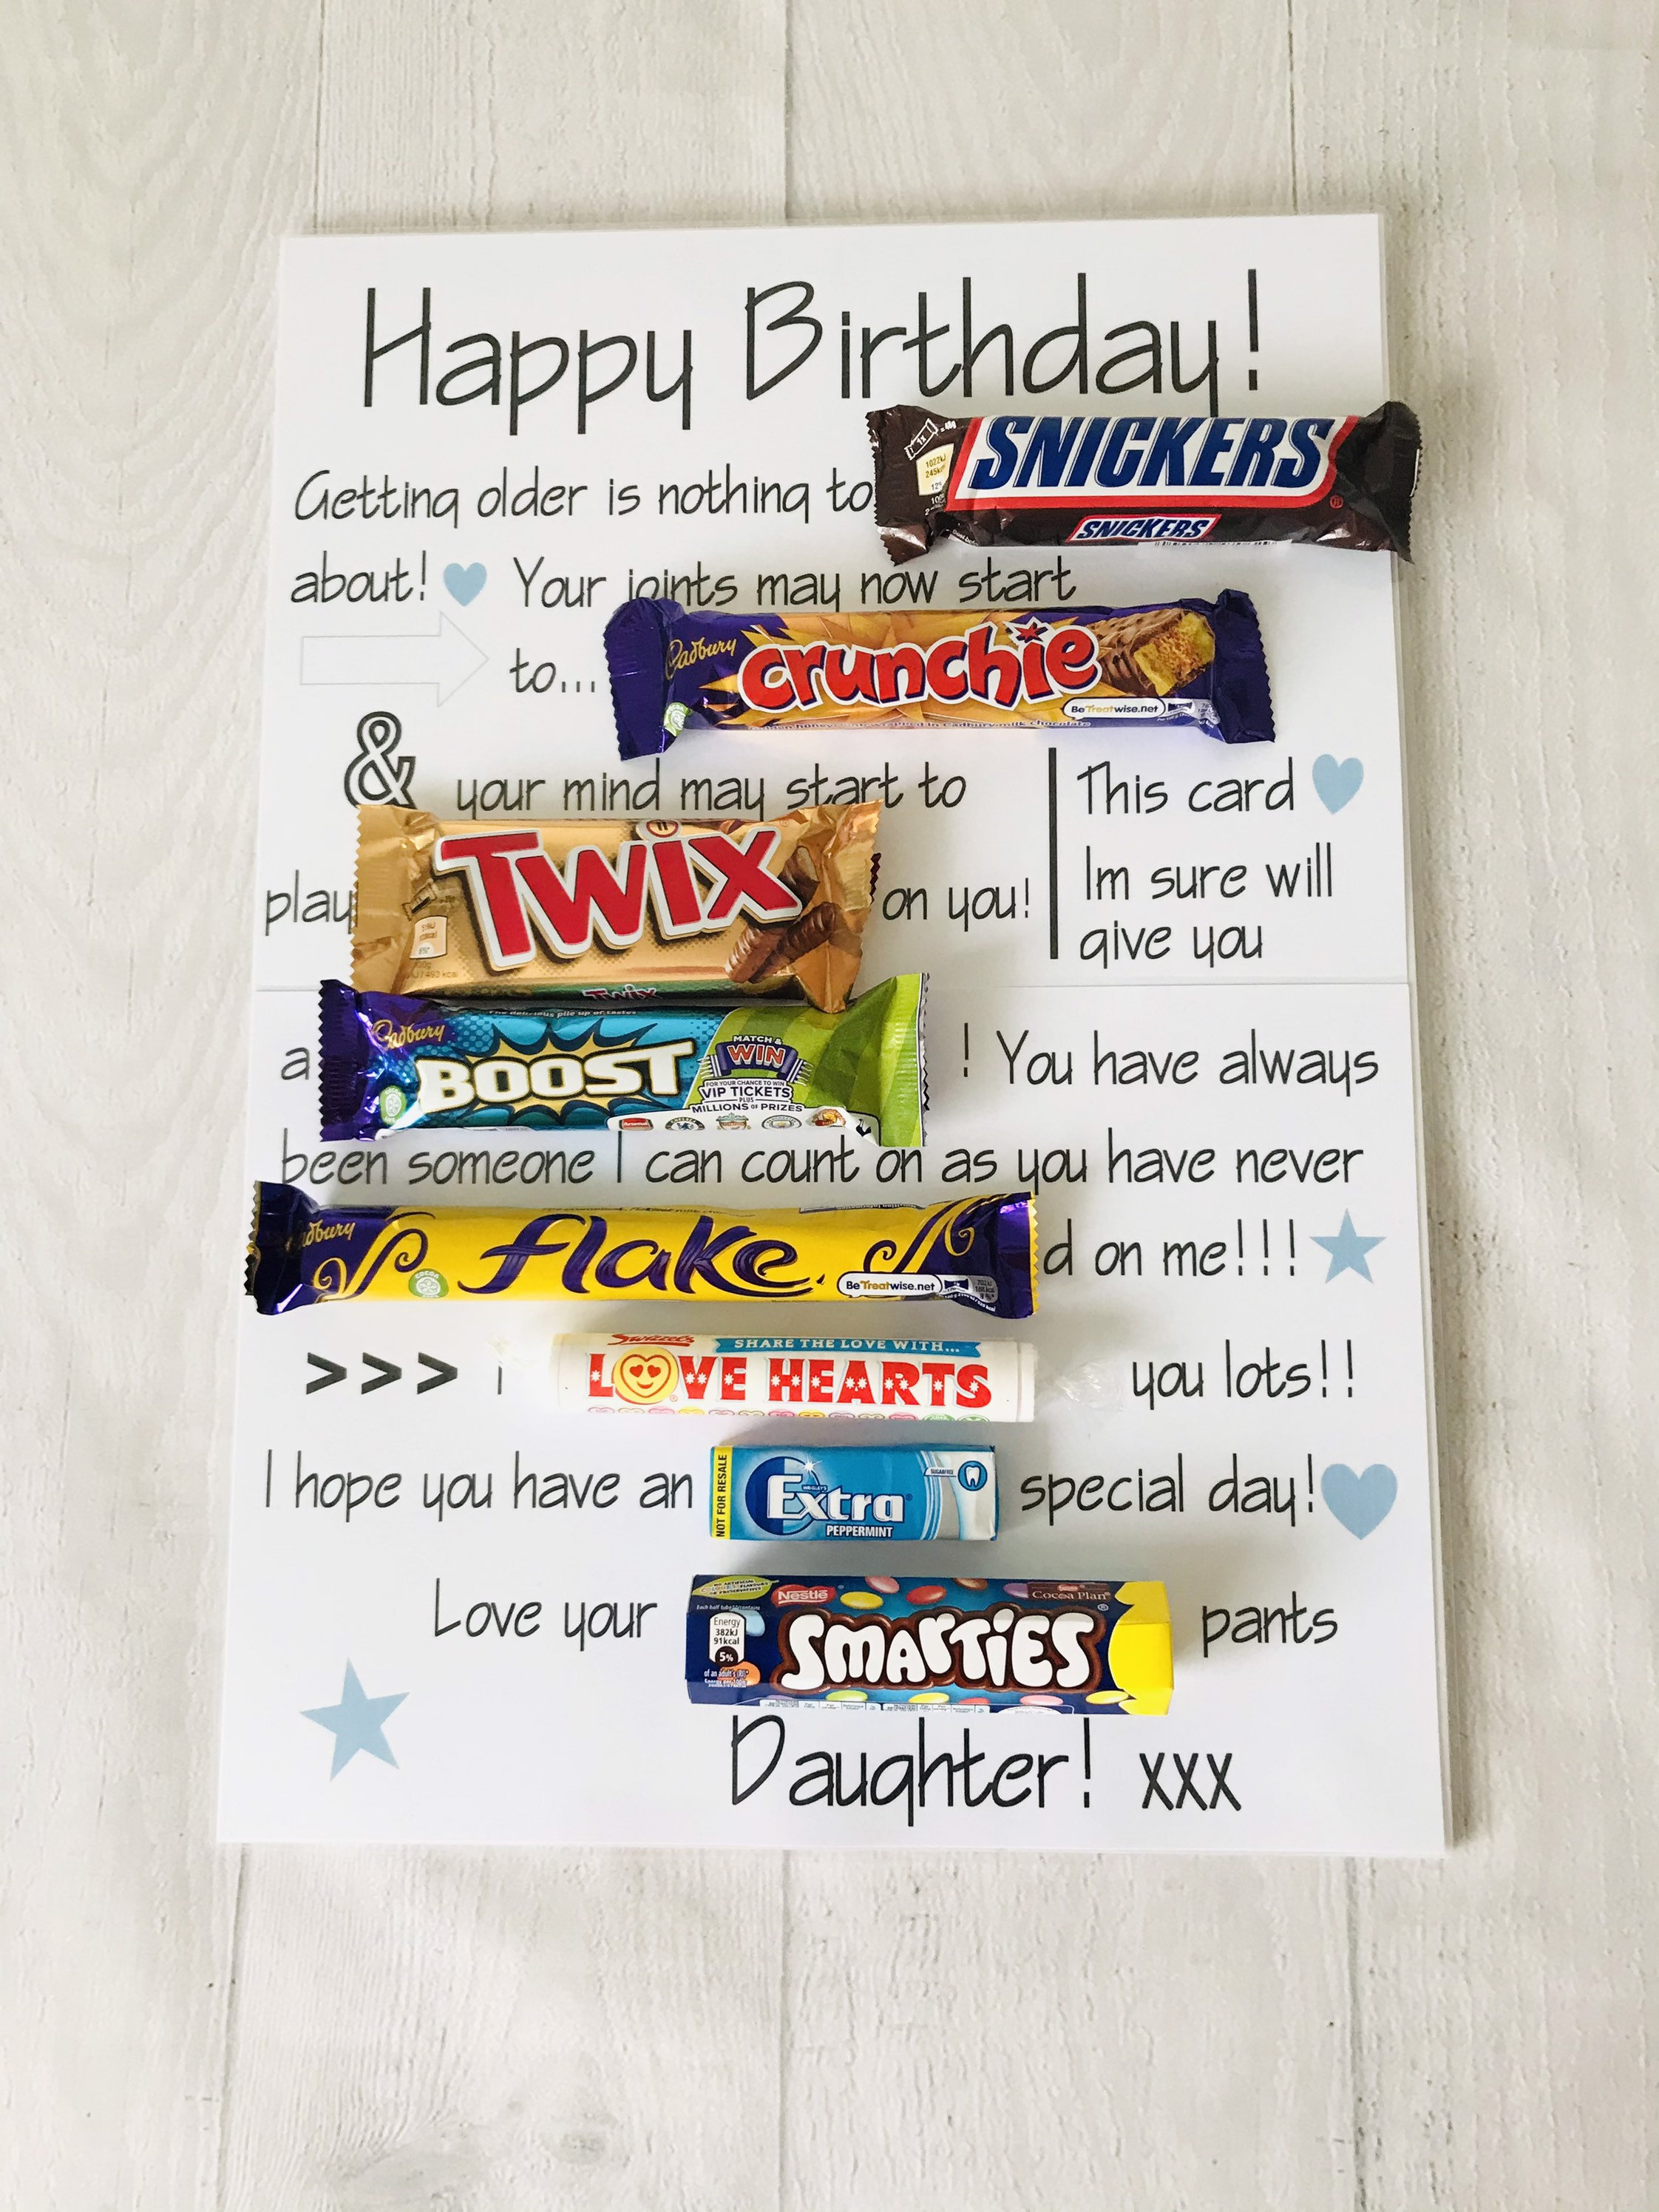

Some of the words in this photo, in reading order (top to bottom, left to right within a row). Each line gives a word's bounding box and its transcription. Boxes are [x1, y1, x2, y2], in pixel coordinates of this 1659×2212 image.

[364, 287, 693, 436] Happy
[744, 268, 1259, 417] Birthday!
[967, 415, 1335, 491] SNICKERS
[295, 469, 458, 529] Getting
[477, 465, 588, 518] older
[609, 478, 641, 516] is
[658, 463, 810, 524] nothing
[826, 467, 873, 512] to
[1078, 518, 1211, 541] SNICKERS
[291, 550, 426, 603] about!
[513, 556, 607, 608] Your
[625, 560, 738, 608] joints
[756, 573, 841, 612] may
[860, 570, 939, 605] now
[958, 554, 1077, 604] start
[509, 648, 595, 693] to...
[666, 637, 738, 681] Cadbury
[344, 710, 416, 809] &
[457, 779, 546, 817] your
[563, 755, 660, 812] mind
[680, 777, 765, 821] may
[786, 761, 904, 810] start
[917, 761, 966, 809] to
[1076, 761, 1168, 815] This
[1188, 756, 1294, 812] card
[1086, 845, 1129, 900] Im
[1150, 865, 1247, 900] sure
[1265, 842, 1332, 898] will
[265, 869, 353, 937] play
[882, 887, 928, 921] on
[949, 878, 1029, 932] you!
[1079, 920, 1172, 969] give
[1193, 926, 1263, 968] you
[372, 1019, 445, 1050] Cadbury
[727, 1044, 786, 1068] WIN
[281, 1047, 310, 1080] a
[417, 1037, 697, 1113] BOOST
[996, 1030, 1073, 1085] You
[1093, 1030, 1199, 1085] have
[1219, 1028, 1379, 1097] always
[692, 1103, 749, 1113] MILLIONS
[761, 1103, 803, 1111] PRIZES
[702, 1087, 726, 1098] VIP
[730, 1087, 790, 1098] TICKETS
[281, 1127, 387, 1184] been
[408, 1150, 595, 1186] someone
[645, 1149, 722, 1184] can
[741, 1134, 860, 1184] count
[875, 1149, 923, 1183] on
[941, 1148, 997, 1184] as
[1017, 1148, 1088, 1195] you
[1107, 1127, 1215, 1184] have
[1236, 1148, 1364, 1184] never
[286, 1219, 356, 1252] dbury
[457, 1212, 813, 1300] flake
[1095, 1241, 1142, 1276] on
[1162, 1218, 1295, 1277] me!!!
[846, 1280, 935, 1292] BeTreatwise.net
[608, 1334, 695, 1346] Swizzels
[734, 1339, 794, 1348] SHARE
[801, 1340, 835, 1348] THE
[840, 1340, 886, 1349] LOVE
[893, 1340, 960, 1353] WITH...
[767, 1357, 992, 1408] HEARTS
[1133, 1361, 1204, 1411] you
[1225, 1339, 1353, 1399] lots!!
[265, 1449, 272, 1507] I
[295, 1451, 401, 1523] hope
[423, 1473, 492, 1522] you
[513, 1451, 620, 1509] have
[639, 1473, 693, 1509] an
[719, 1453, 728, 1492] RESALE
[1020, 1453, 1184, 1527] special
[1208, 1453, 1314, 1527] day!
[717, 1495, 727, 1513] FOR
[766, 1474, 904, 1523] Extra
[715, 1518, 726, 1537] NOT
[826, 1524, 893, 1538] PEPPERMINT
[434, 1578, 542, 1638] Love
[564, 1602, 658, 1652] your
[1032, 1591, 1074, 1599] Cocoa
[1078, 1592, 1106, 1600] Plan
[714, 1617, 741, 1628] Energy
[1201, 1590, 1338, 1658] pants
[704, 1669, 710, 1677] of
[718, 1669, 736, 1677] adult's
[719, 1652, 734, 1662] 5%
[730, 1714, 1091, 1828] Daughter!
